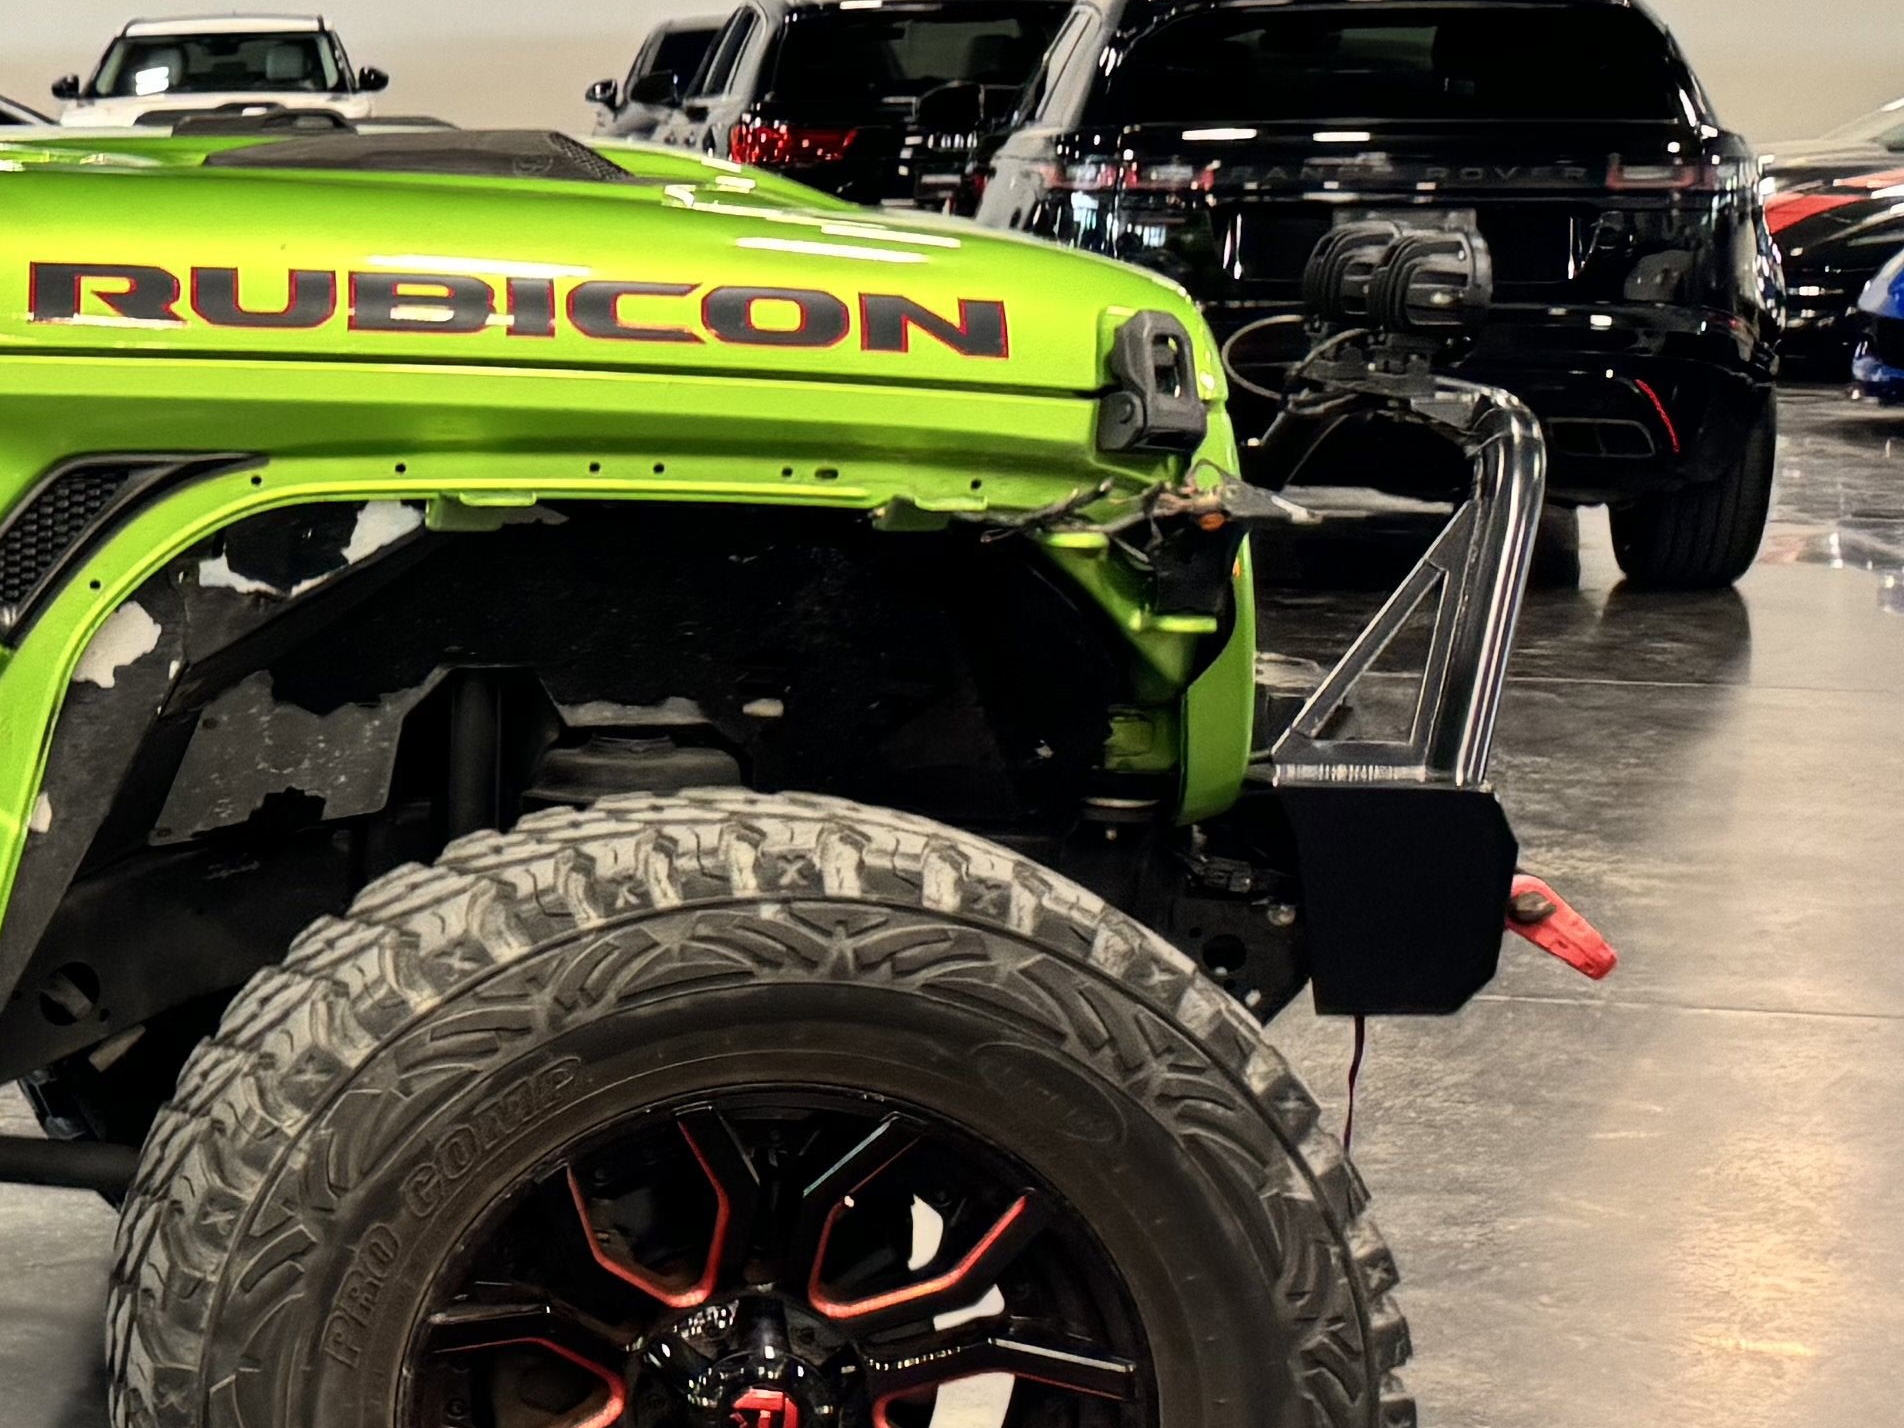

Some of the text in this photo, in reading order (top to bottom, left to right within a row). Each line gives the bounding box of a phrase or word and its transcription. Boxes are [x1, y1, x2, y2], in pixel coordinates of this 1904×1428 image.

[27, 260, 1009, 360] RUBICON
[320, 1056, 582, 1368] PRO COMP
